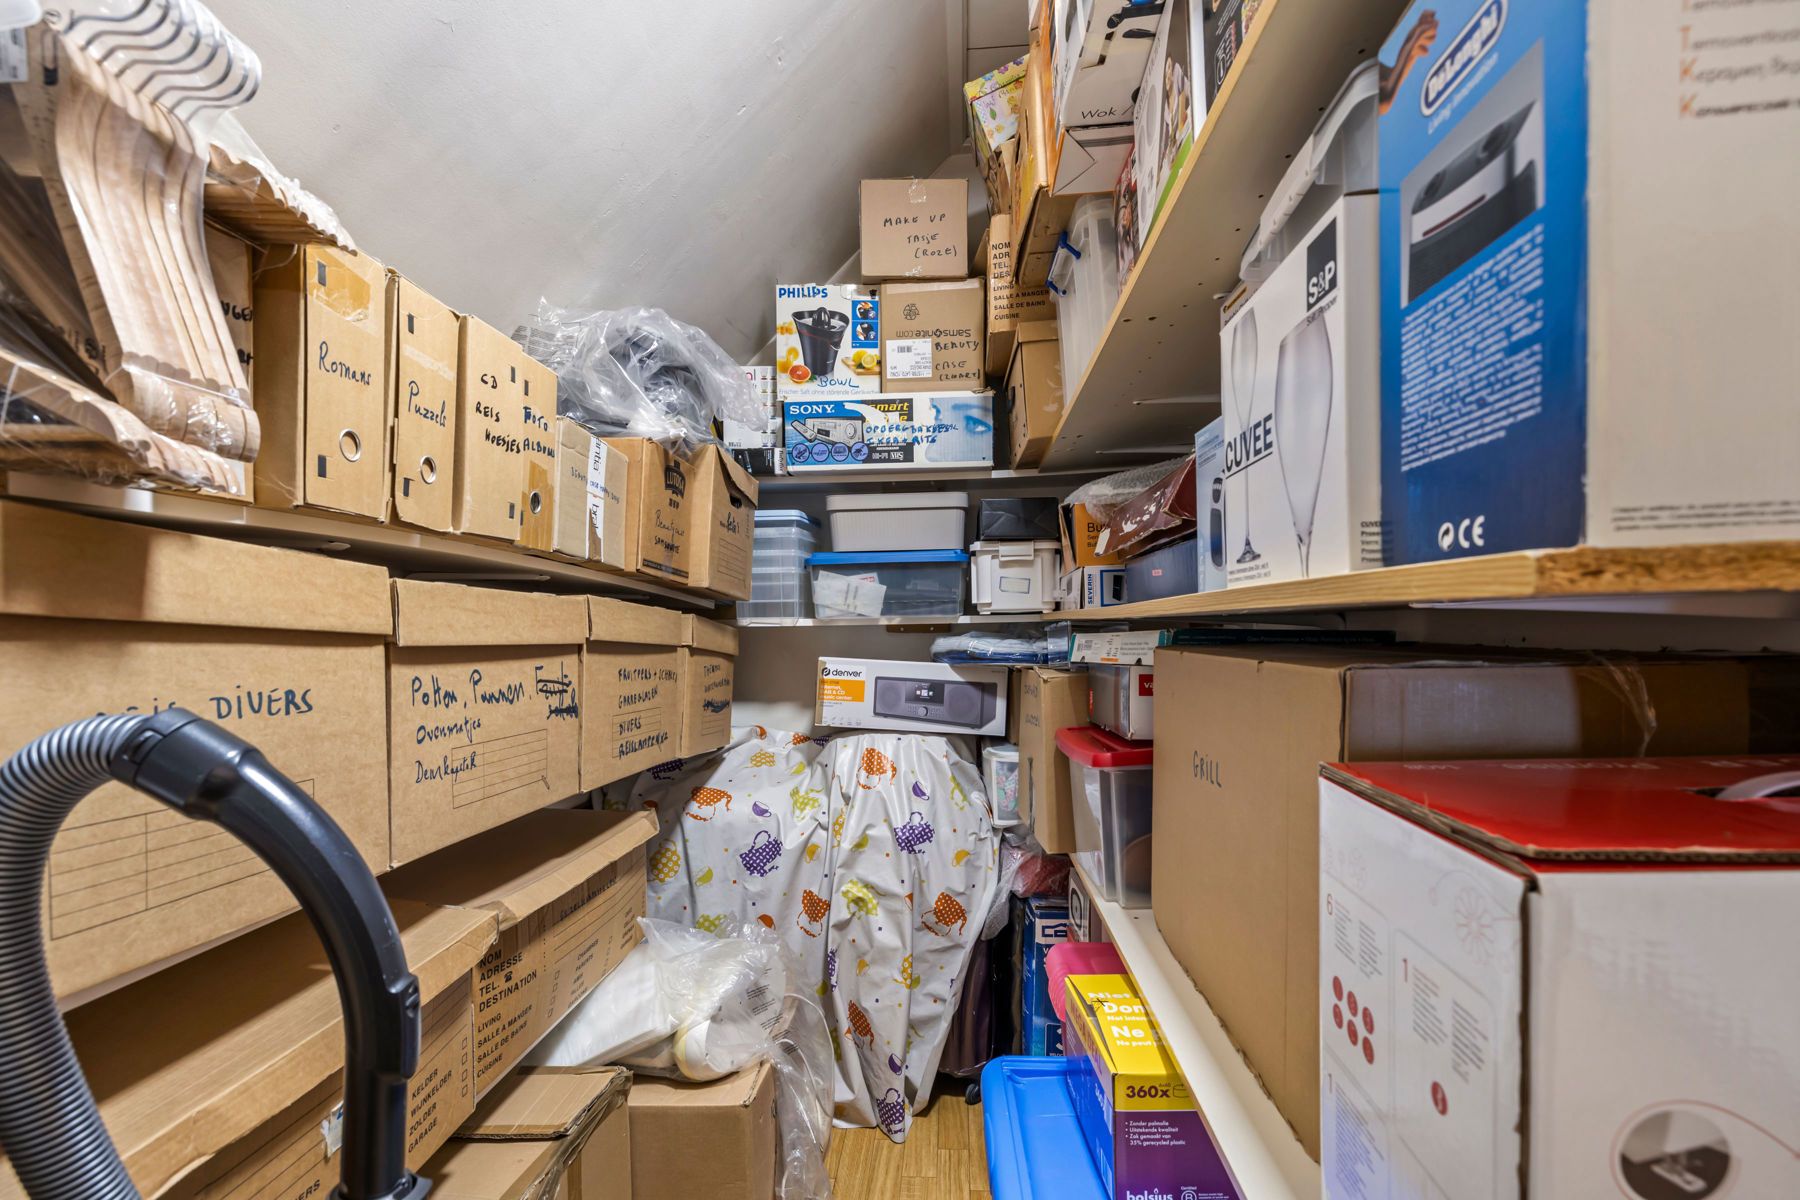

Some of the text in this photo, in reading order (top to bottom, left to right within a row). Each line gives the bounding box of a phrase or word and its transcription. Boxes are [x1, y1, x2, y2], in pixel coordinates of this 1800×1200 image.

[1081, 105, 1116, 120] Wok
[883, 213, 946, 228] MAKE UP
[914, 245, 958, 259] (ROZE)
[778, 286, 829, 299] PHILIPS
[993, 283, 1015, 292] LIVING
[1308, 260, 1336, 304] S&P
[994, 292, 1014, 301] SALLE
[1021, 289, 1049, 297] MANGER
[994, 312, 1020, 320] CUISINE
[934, 340, 980, 352] BEAUTY
[318, 340, 372, 386] Romans
[935, 360, 967, 371] CASE
[480, 373, 498, 390] CD
[816, 375, 860, 388] BOWL
[407, 380, 447, 428] Puzzels
[475, 401, 501, 423] REIS
[789, 404, 835, 415] SONY
[523, 405, 549, 432] FOTO
[1225, 412, 1273, 473] CUVEE
[831, 668, 863, 677] denver
[1326, 893, 1333, 916] 6
[479, 948, 502, 969] NOM
[479, 951, 524, 983] ADRESSE
[479, 981, 500, 997] TEL.
[479, 969, 537, 1012] DESTINATION
[477, 1012, 502, 1033] LIVING
[477, 1030, 500, 1048] SALLE
[507, 1004, 533, 1028] MANGER
[1111, 1025, 1145, 1038] Ne
[477, 1020, 528, 1064] SALLE DE BAINS
[477, 1053, 503, 1078] CUISINE
[410, 1070, 452, 1118] WIJNKELDER
[411, 1067, 438, 1100] KELDER
[1125, 1085, 1170, 1099] 360x
[409, 1102, 438, 1137] ZOLDER
[408, 1116, 438, 1154] GARAGE
